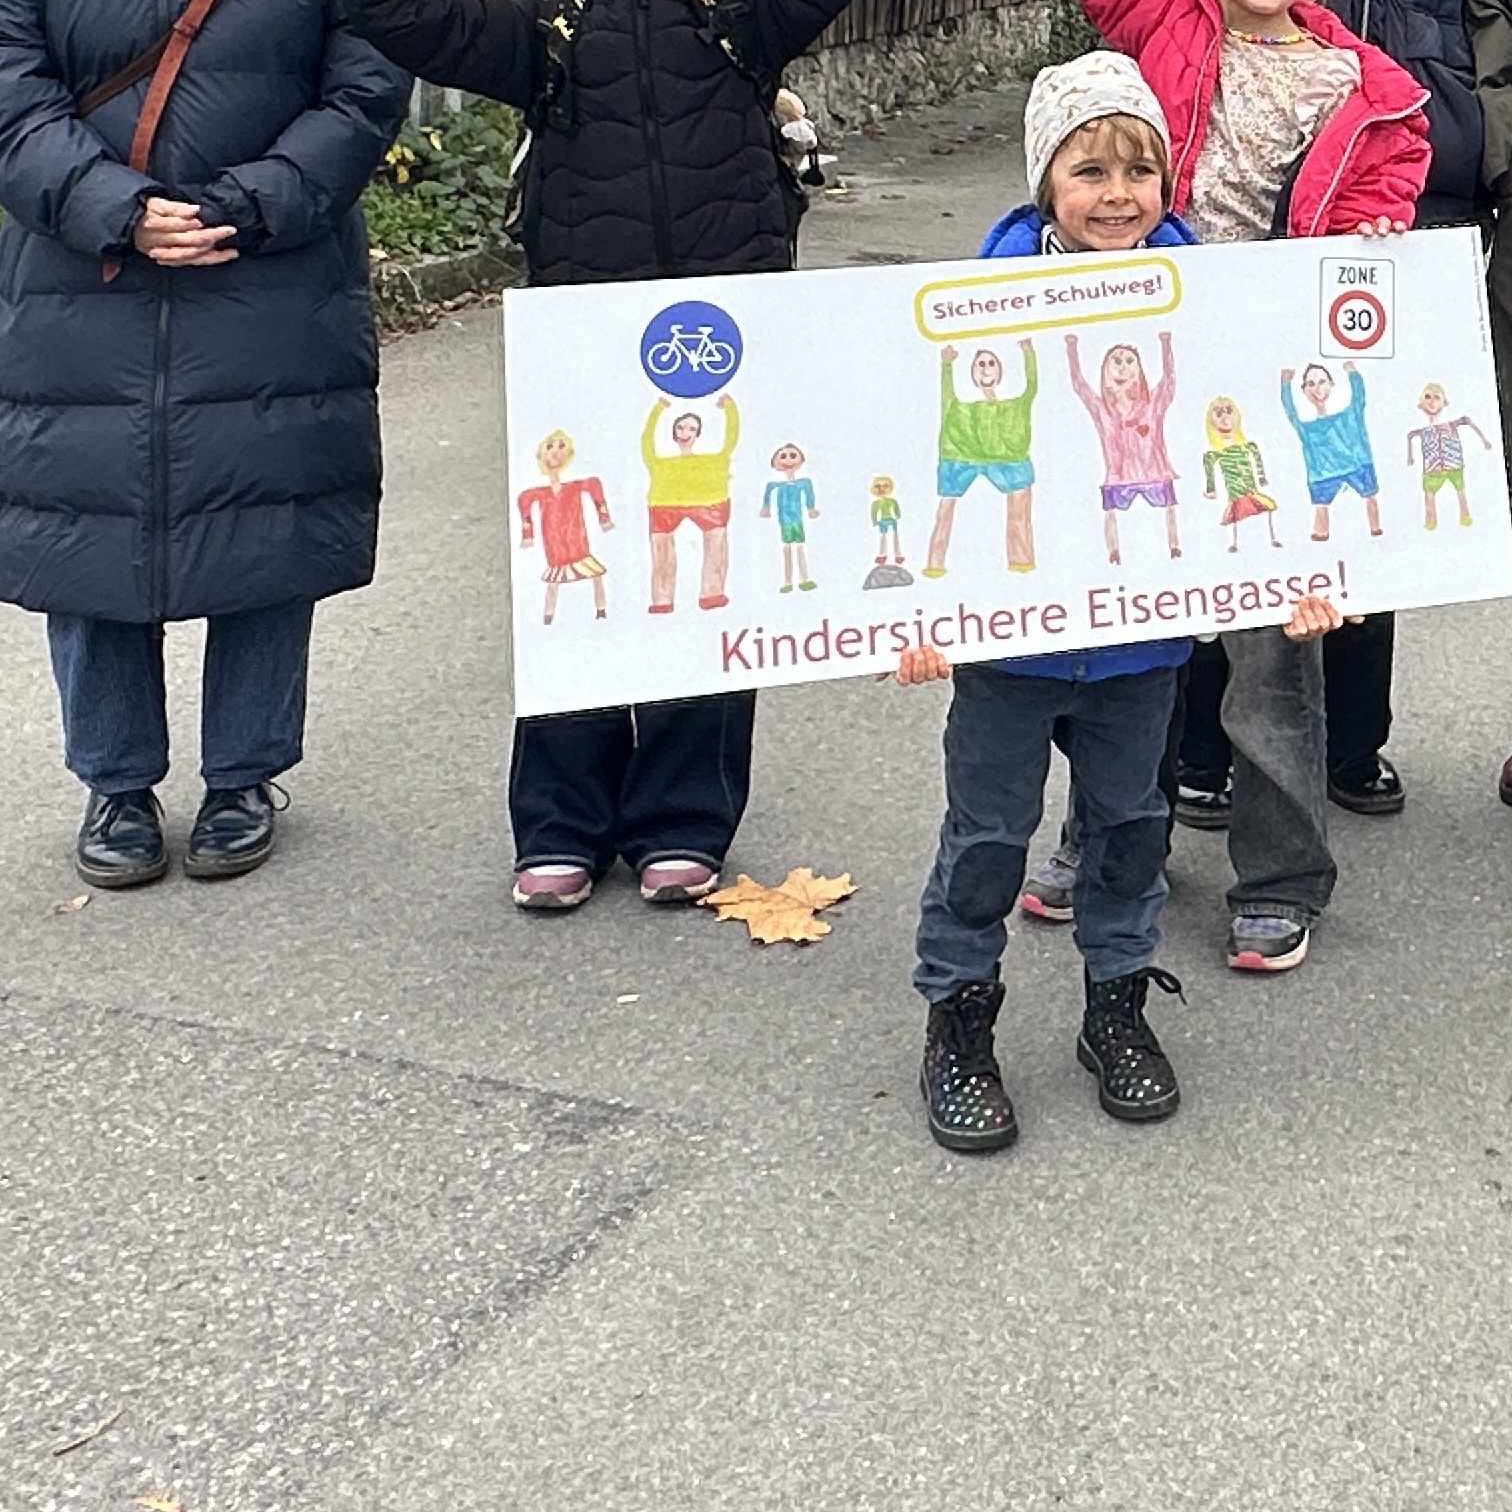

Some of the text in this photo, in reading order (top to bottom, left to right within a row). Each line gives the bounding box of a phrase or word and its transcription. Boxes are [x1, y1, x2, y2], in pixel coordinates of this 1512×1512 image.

[1337, 266, 1378, 285] ZONE
[932, 274, 1162, 319] Sicherer Schulweg!
[1342, 308, 1373, 332] 30
[721, 559, 1349, 673] Kindersichere Eisengasse!
